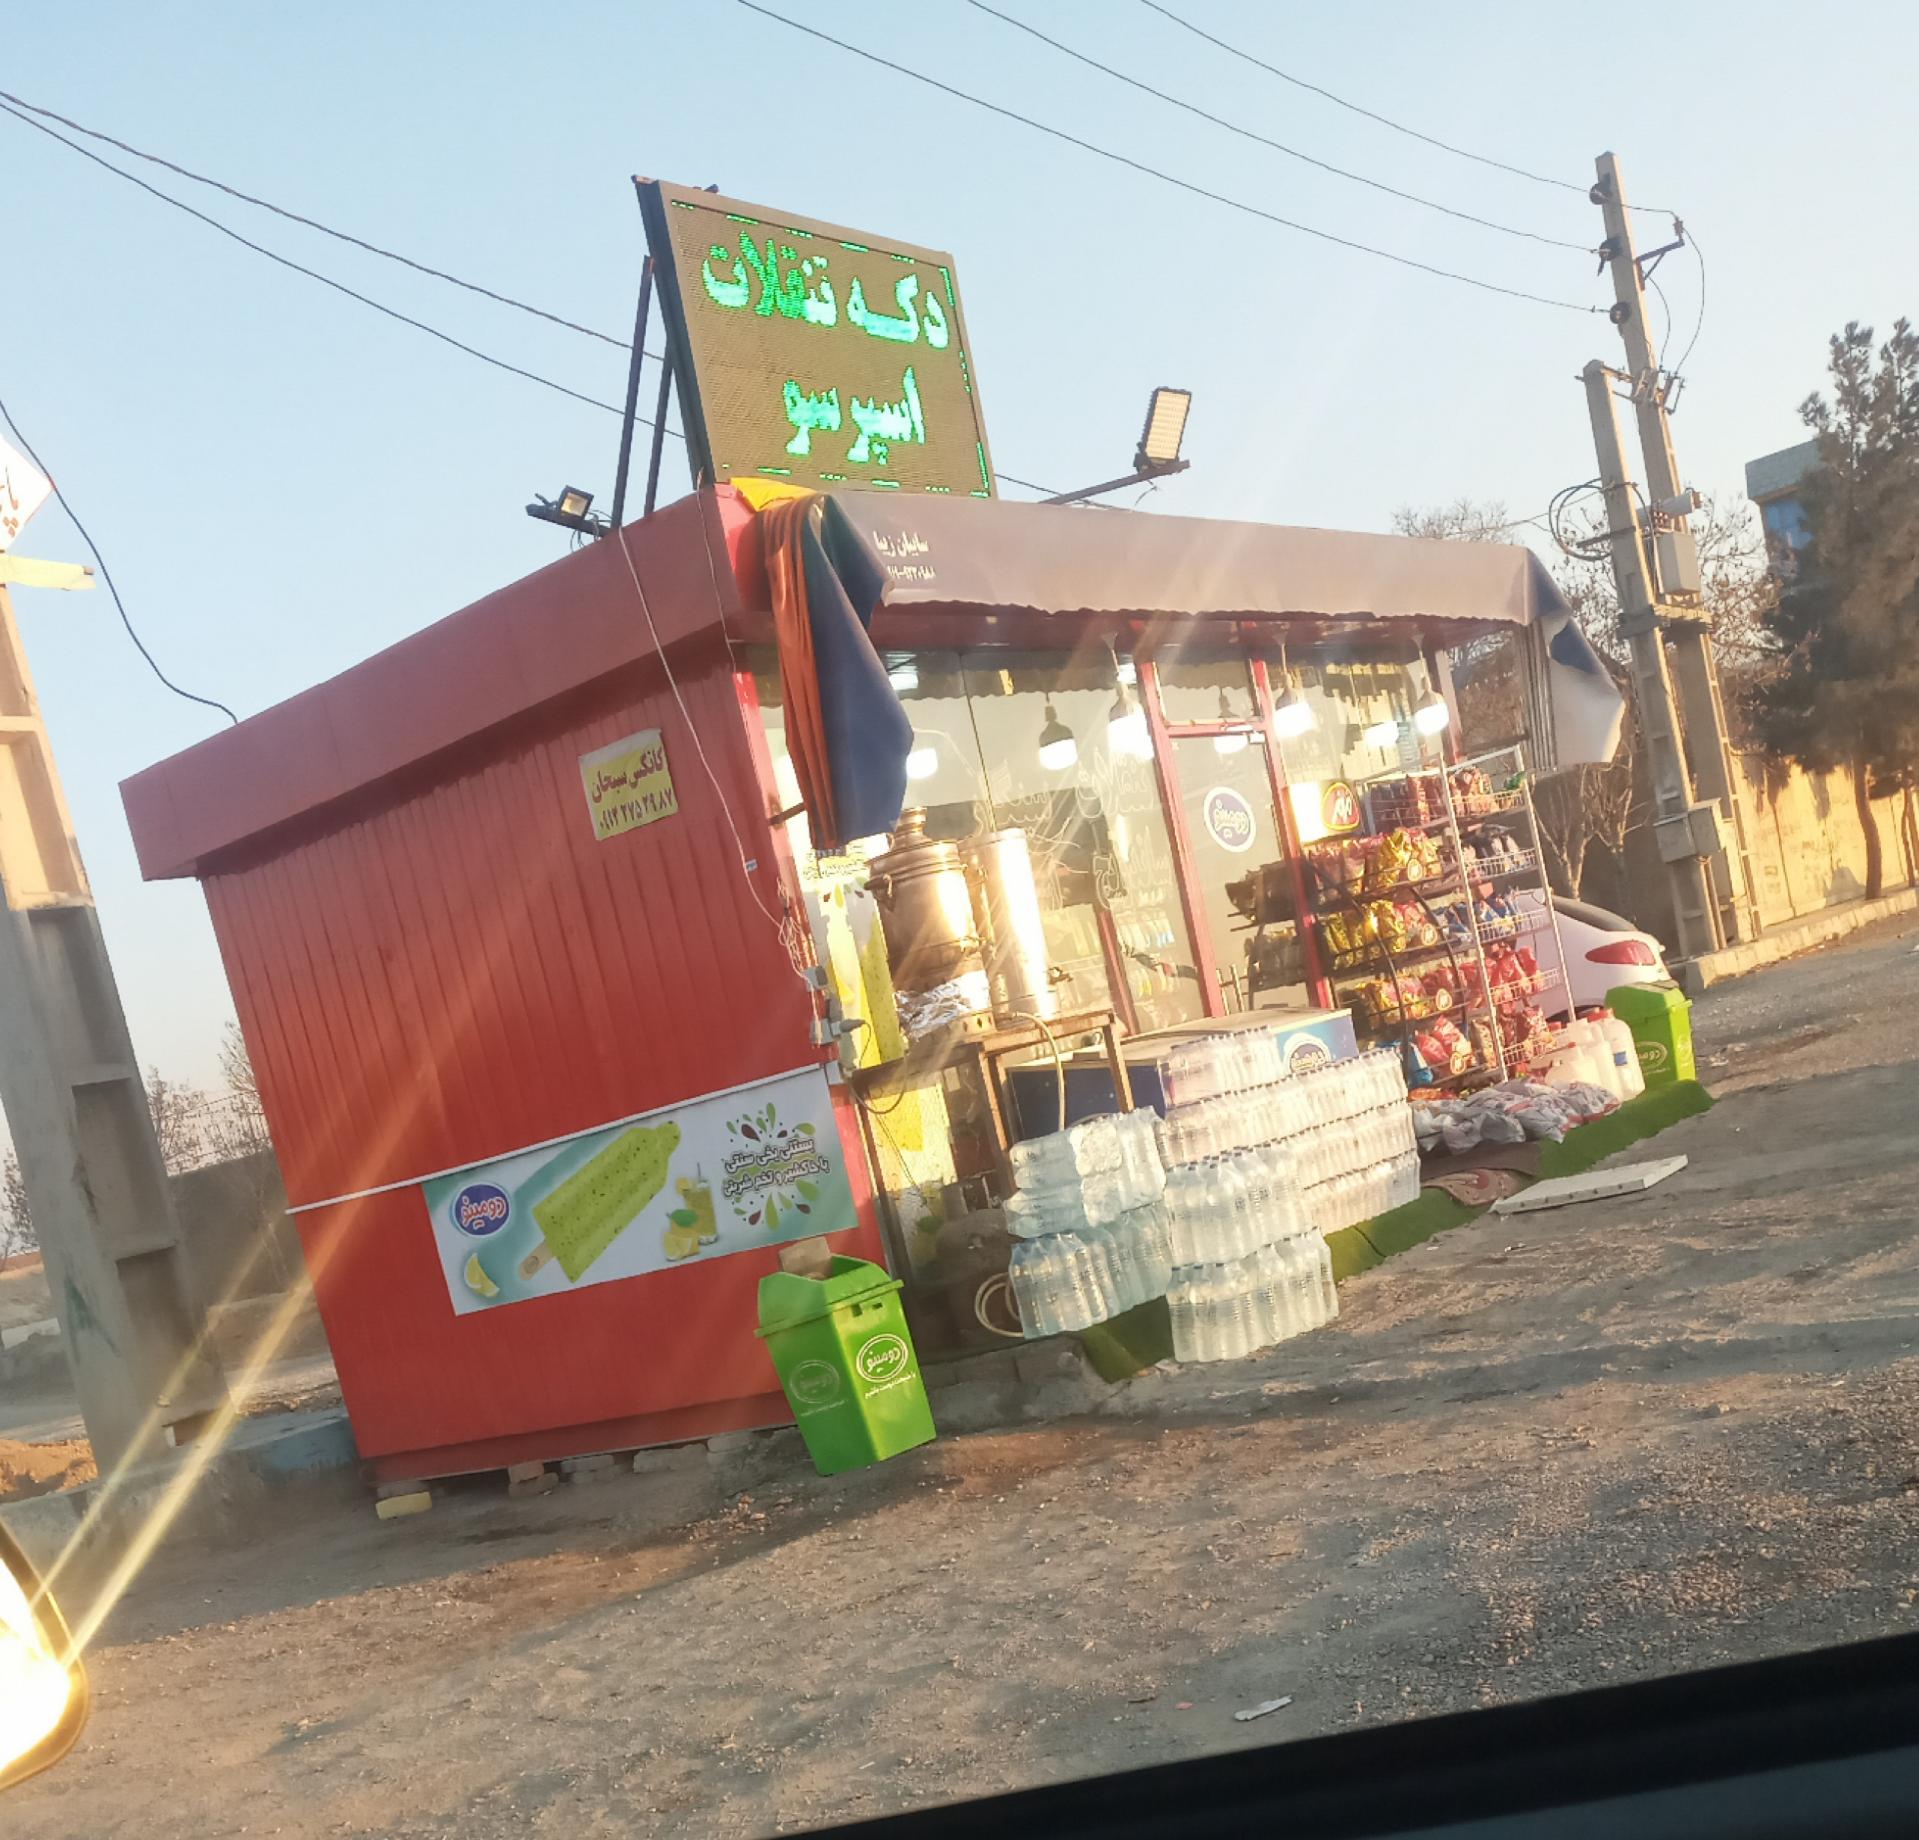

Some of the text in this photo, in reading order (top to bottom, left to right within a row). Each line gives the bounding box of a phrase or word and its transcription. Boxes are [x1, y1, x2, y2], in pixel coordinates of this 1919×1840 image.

[702, 229, 949, 350] دکه تنقلات
[1214, 798, 1250, 839] دومینو
[724, 1138, 816, 1173] بستنی یخی سنتی
[818, 1155, 831, 1173] با
[754, 1169, 774, 1190] تخم
[461, 1195, 507, 1230] دومینو
[866, 1346, 901, 1374] دومینو
